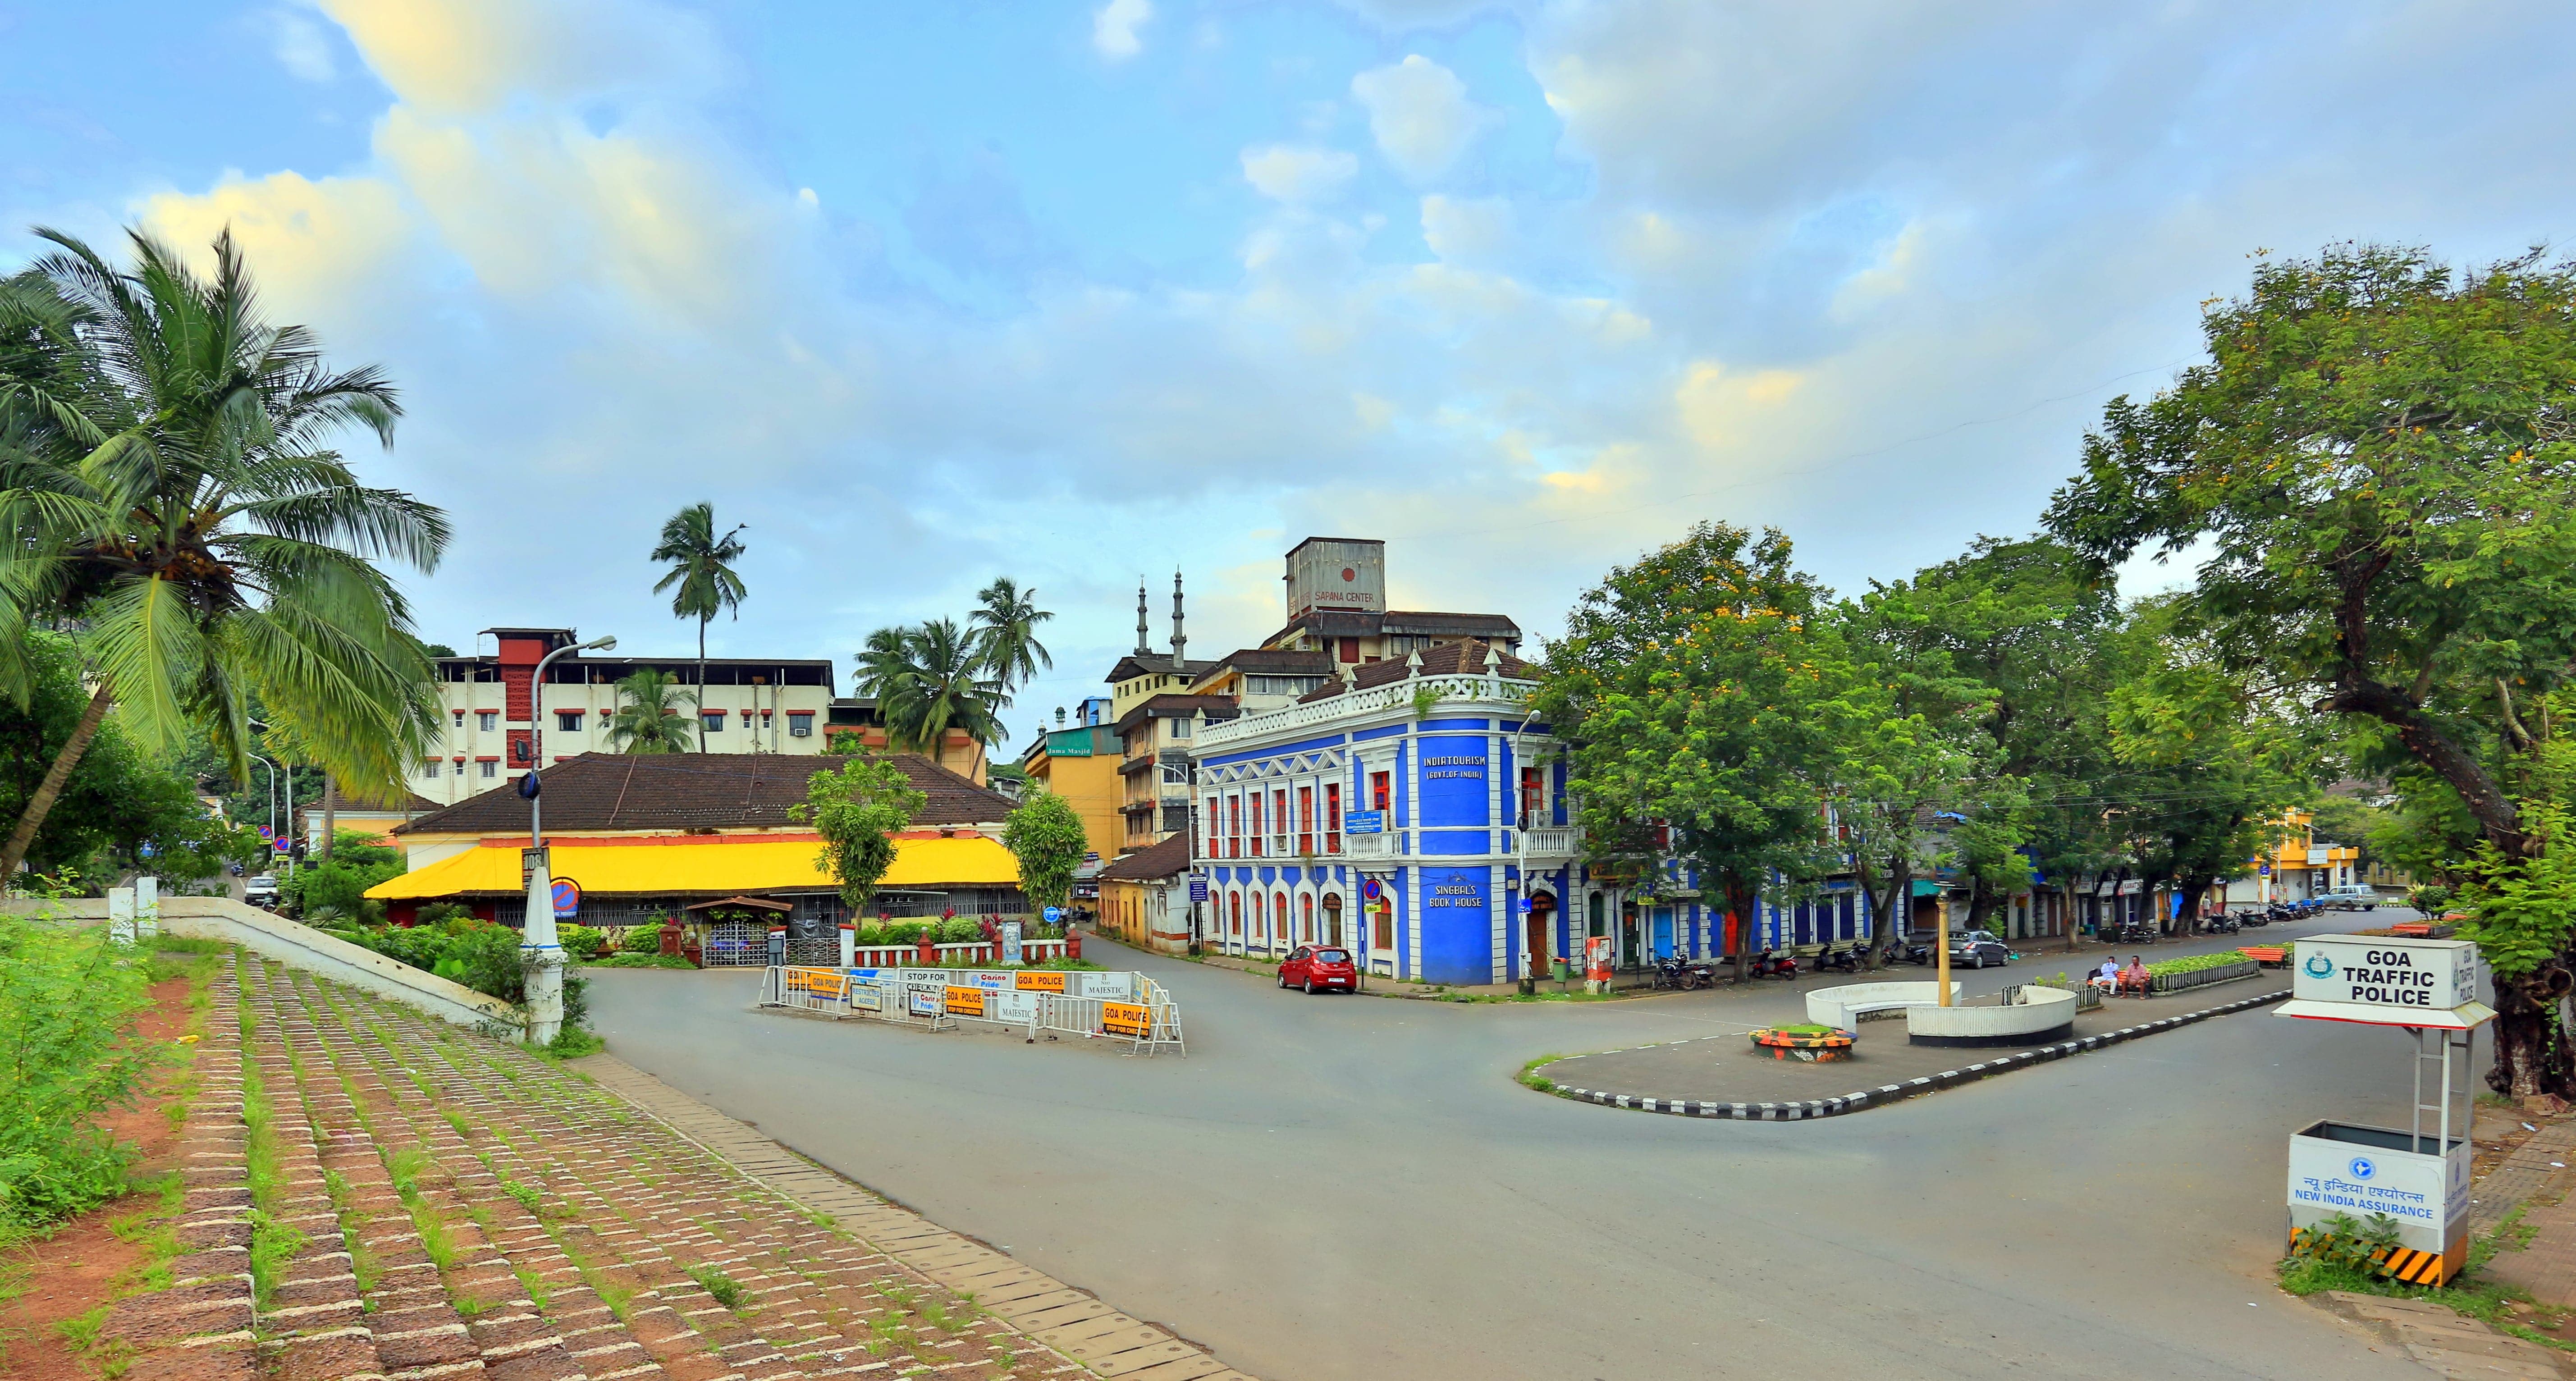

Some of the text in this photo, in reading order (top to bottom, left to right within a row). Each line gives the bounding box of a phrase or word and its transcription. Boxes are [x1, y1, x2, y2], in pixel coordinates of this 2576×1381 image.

[1315, 592, 1344, 601] SAPANA
[1346, 593, 1374, 603] CENTER
[1424, 756, 1486, 767] INDIATOURISM
[1460, 771, 1482, 779] INDIA)
[523, 854, 542, 869] 108
[1436, 885, 1476, 895] SINGBAL'S
[1430, 898, 1482, 907] BOOK HOUSE
[2366, 950, 2411, 967] GOA
[813, 978, 824, 987] GOA
[1018, 976, 1062, 985] GOA POLICE
[2343, 967, 2434, 987] TRAFFIC
[853, 988, 880, 997] RESTRICTED
[947, 991, 958, 1001] GOA
[962, 993, 981, 1003] POLICE
[2352, 986, 2430, 1006] POLICE
[858, 997, 876, 1006] ACCESS
[1002, 1008, 1032, 1018] MAJESTIC
[1105, 1008, 1147, 1022] GOA POLICE
[1127, 1028, 1148, 1036] CHECING
[2303, 1177, 2424, 1203] न्यू इन्डिया एश्योरन्स
[2295, 1189, 2434, 1220] NEW INDIA ASSURANCE
